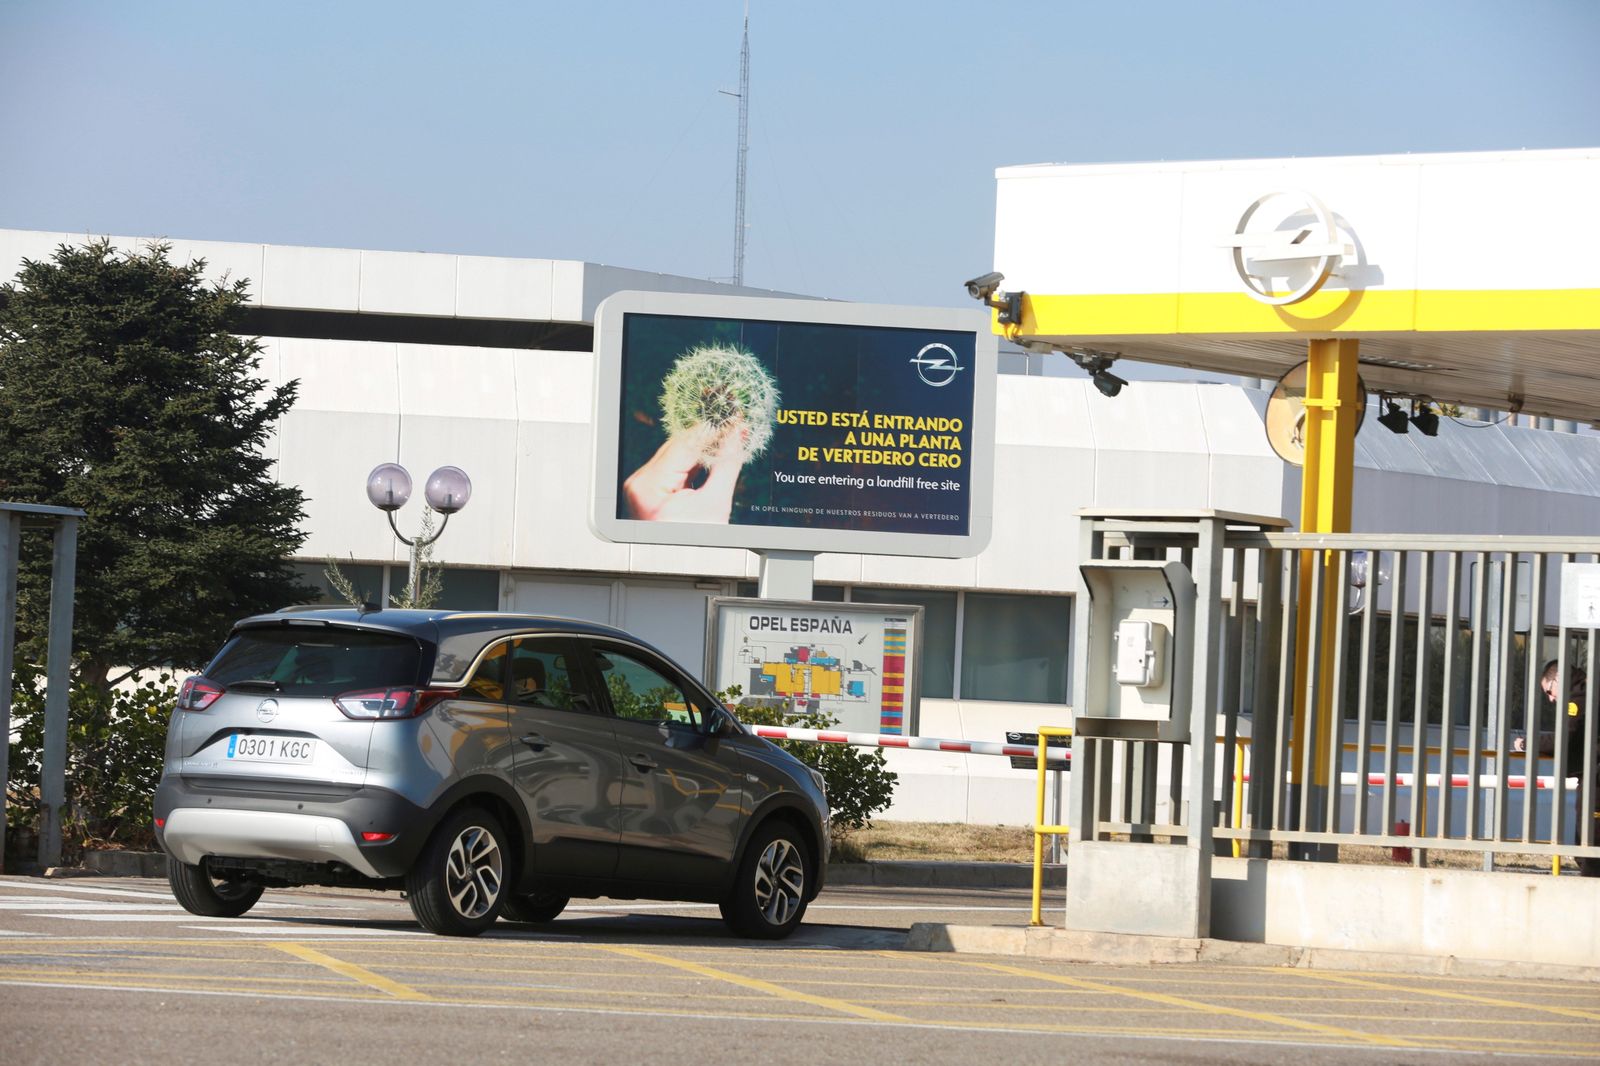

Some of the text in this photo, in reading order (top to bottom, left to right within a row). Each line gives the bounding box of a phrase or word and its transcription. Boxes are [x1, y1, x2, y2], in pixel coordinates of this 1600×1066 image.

[776, 409, 963, 433] USTED ESTÁ ENTRANDO
[844, 431, 962, 451] A UNA PLANTA
[798, 447, 962, 469] DE VERTEDERO CERO
[774, 471, 961, 491] You are entering a landfill free site
[762, 505, 779, 513] OPEL
[781, 506, 813, 515] NINGUNO
[921, 513, 960, 521] VERTEDERO
[749, 615, 853, 634] OPEL ESPAÑA
[239, 738, 310, 758] 0301 KGC
